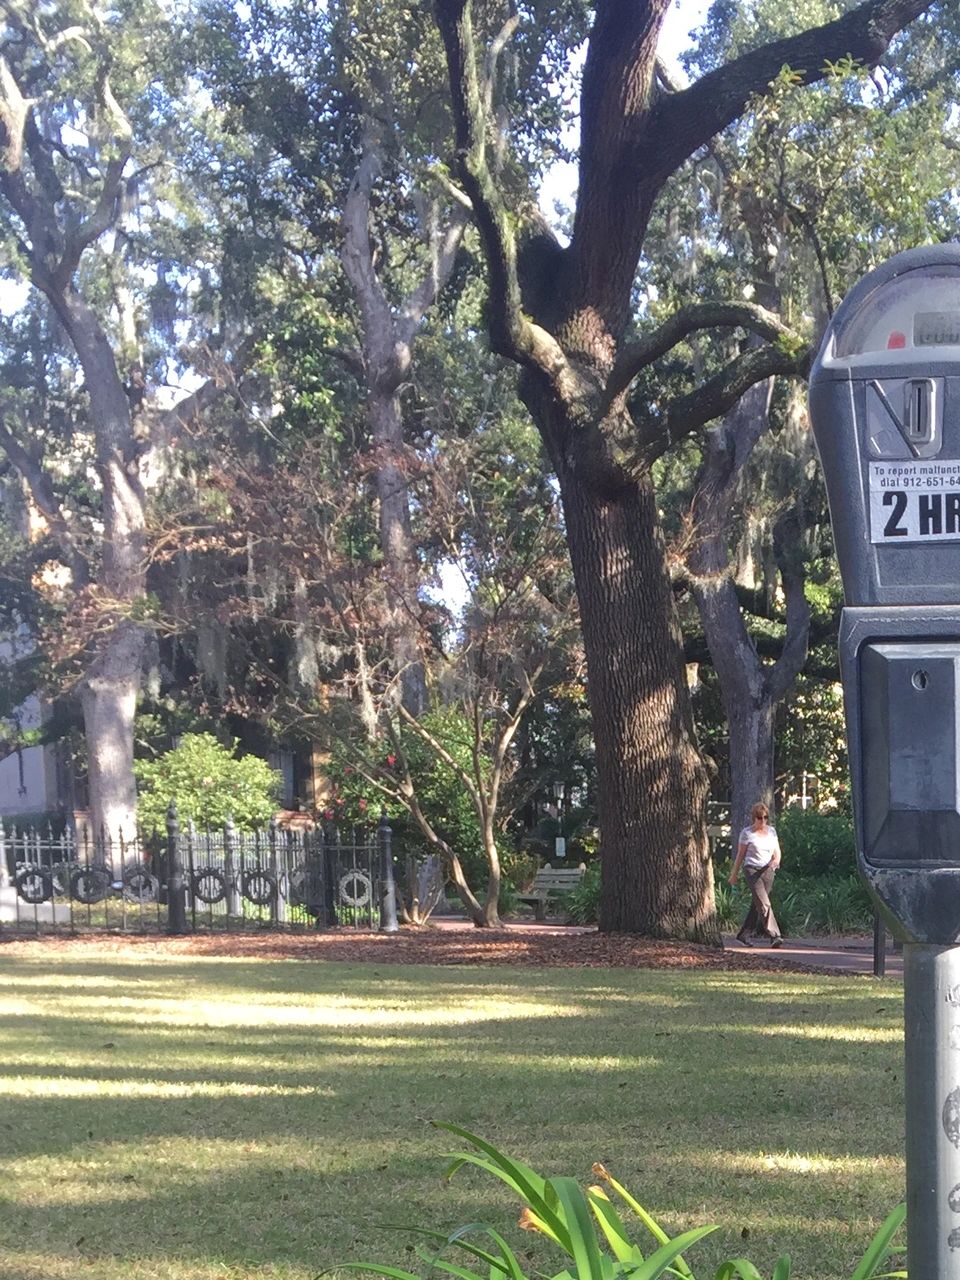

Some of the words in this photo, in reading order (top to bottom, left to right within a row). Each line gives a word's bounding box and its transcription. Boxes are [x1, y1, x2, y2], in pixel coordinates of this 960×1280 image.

[875, 466, 885, 475] To
[888, 466, 916, 477] report
[880, 478, 899, 487] dial
[882, 491, 908, 537] 2
